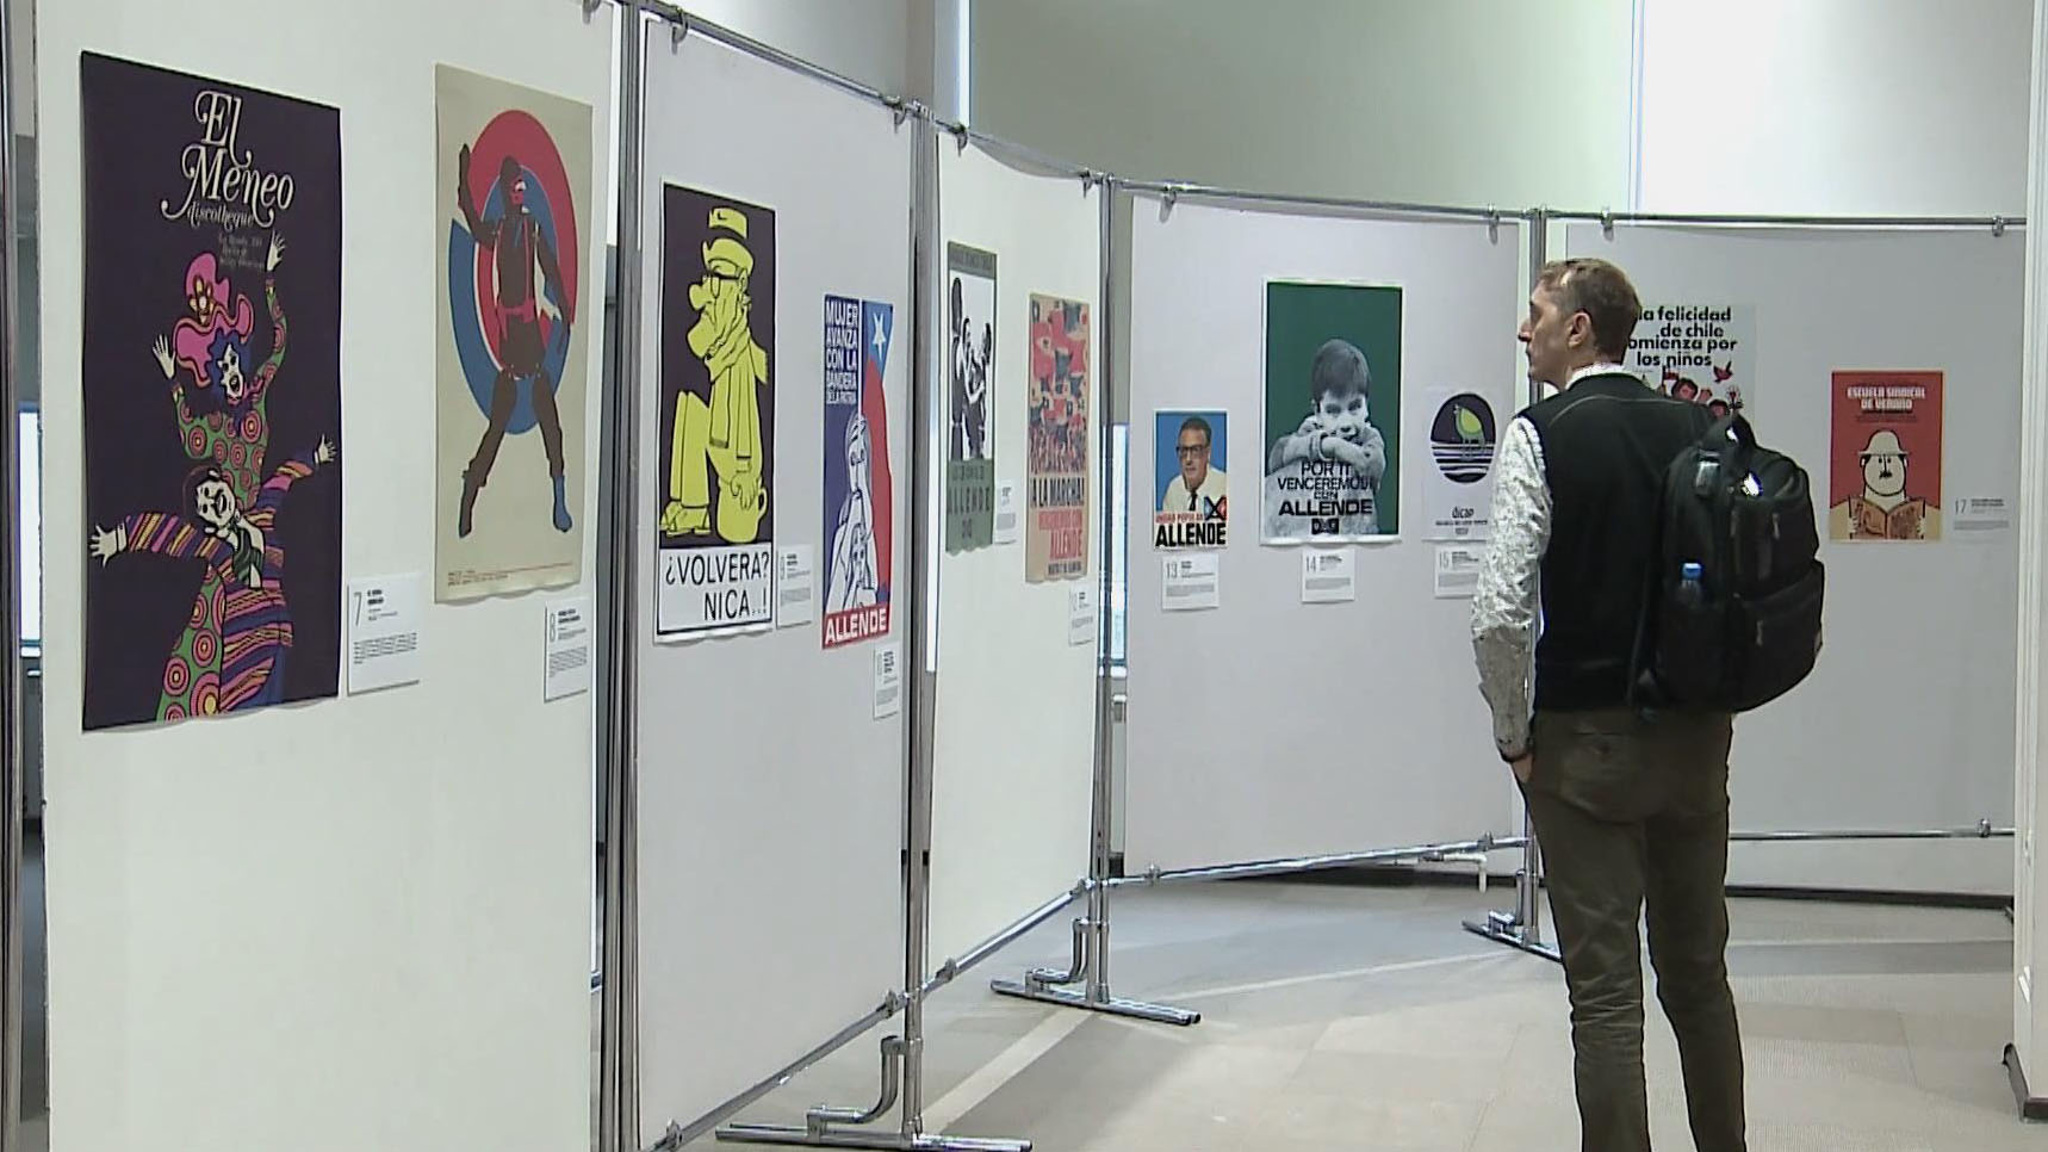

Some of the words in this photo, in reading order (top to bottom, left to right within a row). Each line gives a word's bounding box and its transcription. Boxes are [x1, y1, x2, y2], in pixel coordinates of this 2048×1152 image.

[195, 90, 253, 168] El
[161, 144, 295, 228] Meneo
[186, 201, 255, 232] discotheque
[826, 300, 858, 327] MUJER
[1658, 305, 1731, 321] felicidad
[827, 326, 858, 351] AVANZA
[1660, 322, 1682, 338] de
[1686, 322, 1724, 338] chile
[1628, 335, 1703, 350] omienza
[1707, 339, 1738, 354] por
[826, 348, 844, 371] CON
[846, 349, 858, 372] LA
[1637, 351, 1661, 366] los
[1667, 350, 1712, 367] niños
[1861, 398, 1874, 410] DE
[1301, 460, 1335, 476] POR
[1338, 461, 1352, 476] TI
[948, 486, 990, 515] ALLENDE
[1314, 491, 1338, 499] CON
[1279, 499, 1373, 516] ALLENDE
[1050, 528, 1083, 559] ALLENDE
[1155, 523, 1226, 547] ALLENDE
[665, 551, 770, 585] ¿VOLVERA?
[353, 591, 362, 627] 7
[825, 608, 887, 645] ALLENDE
